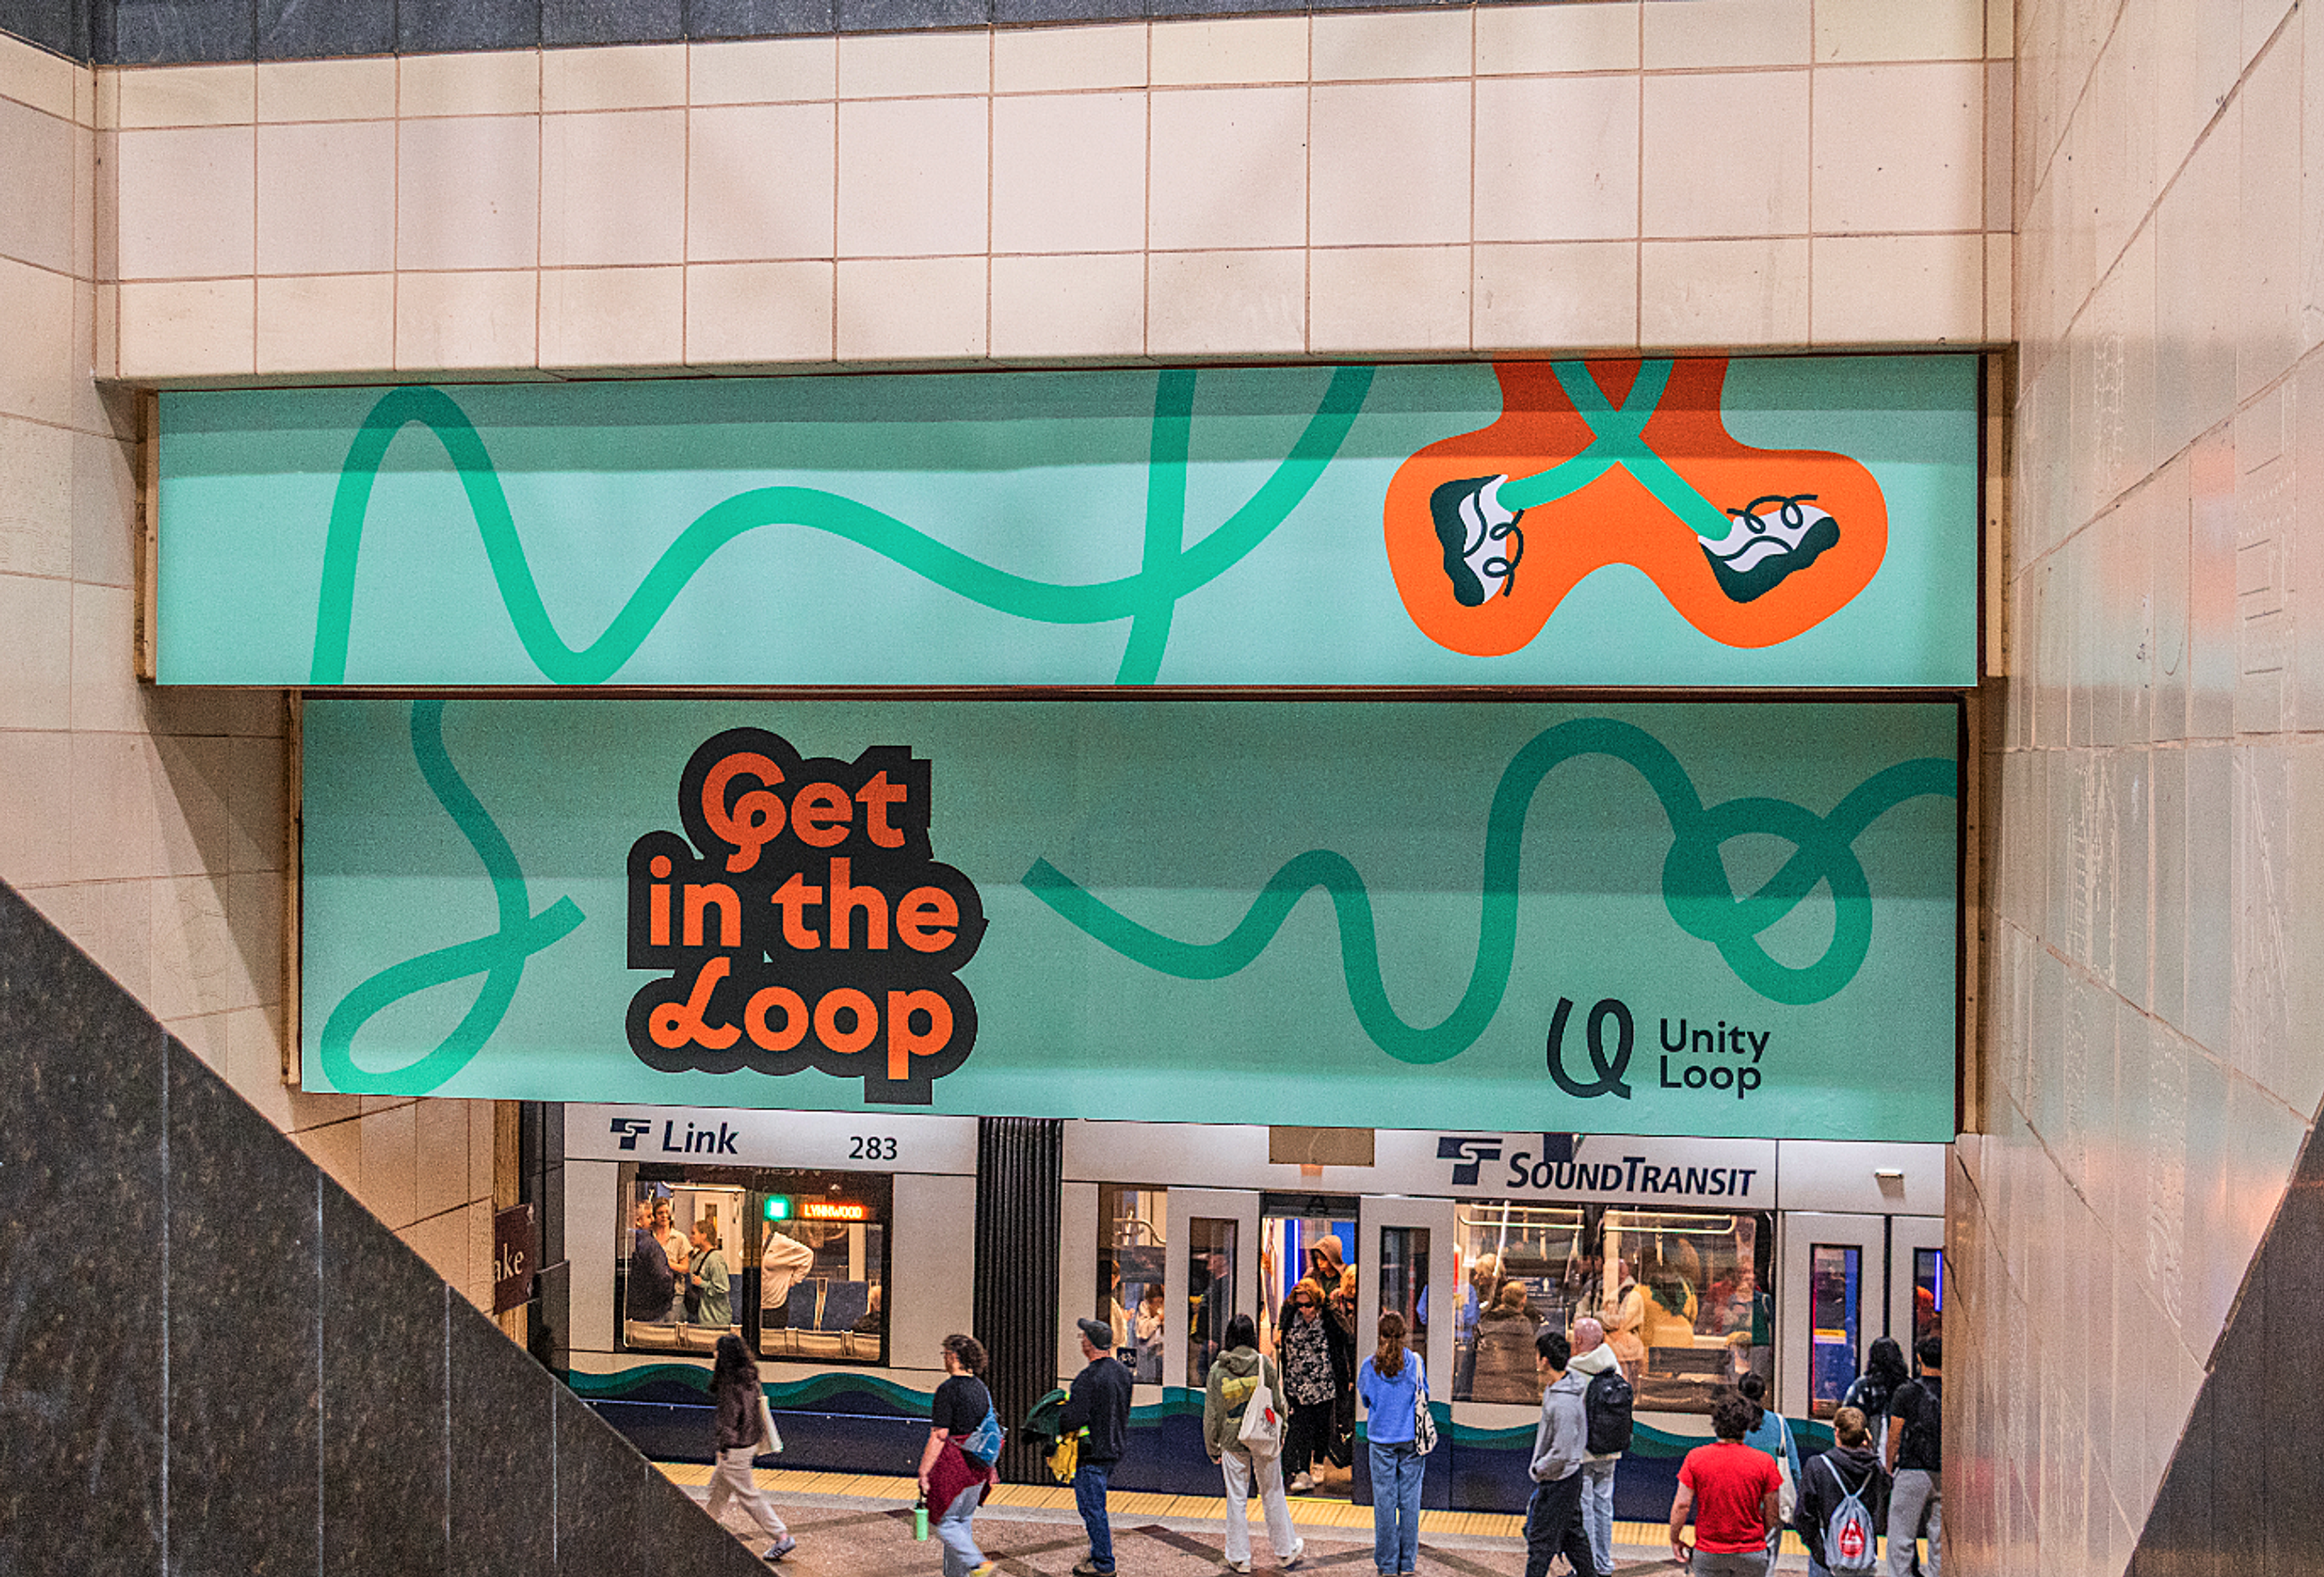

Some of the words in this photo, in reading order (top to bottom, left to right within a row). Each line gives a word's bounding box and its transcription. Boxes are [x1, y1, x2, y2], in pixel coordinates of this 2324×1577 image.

[701, 752, 907, 873] Get
[650, 855, 741, 946] in
[771, 857, 959, 952] the
[649, 956, 953, 1080] Loop
[1660, 1018, 1771, 1063] Unity
[1660, 1055, 1761, 1100] Loop
[662, 1120, 739, 1154] Link
[849, 1136, 898, 1160] 283
